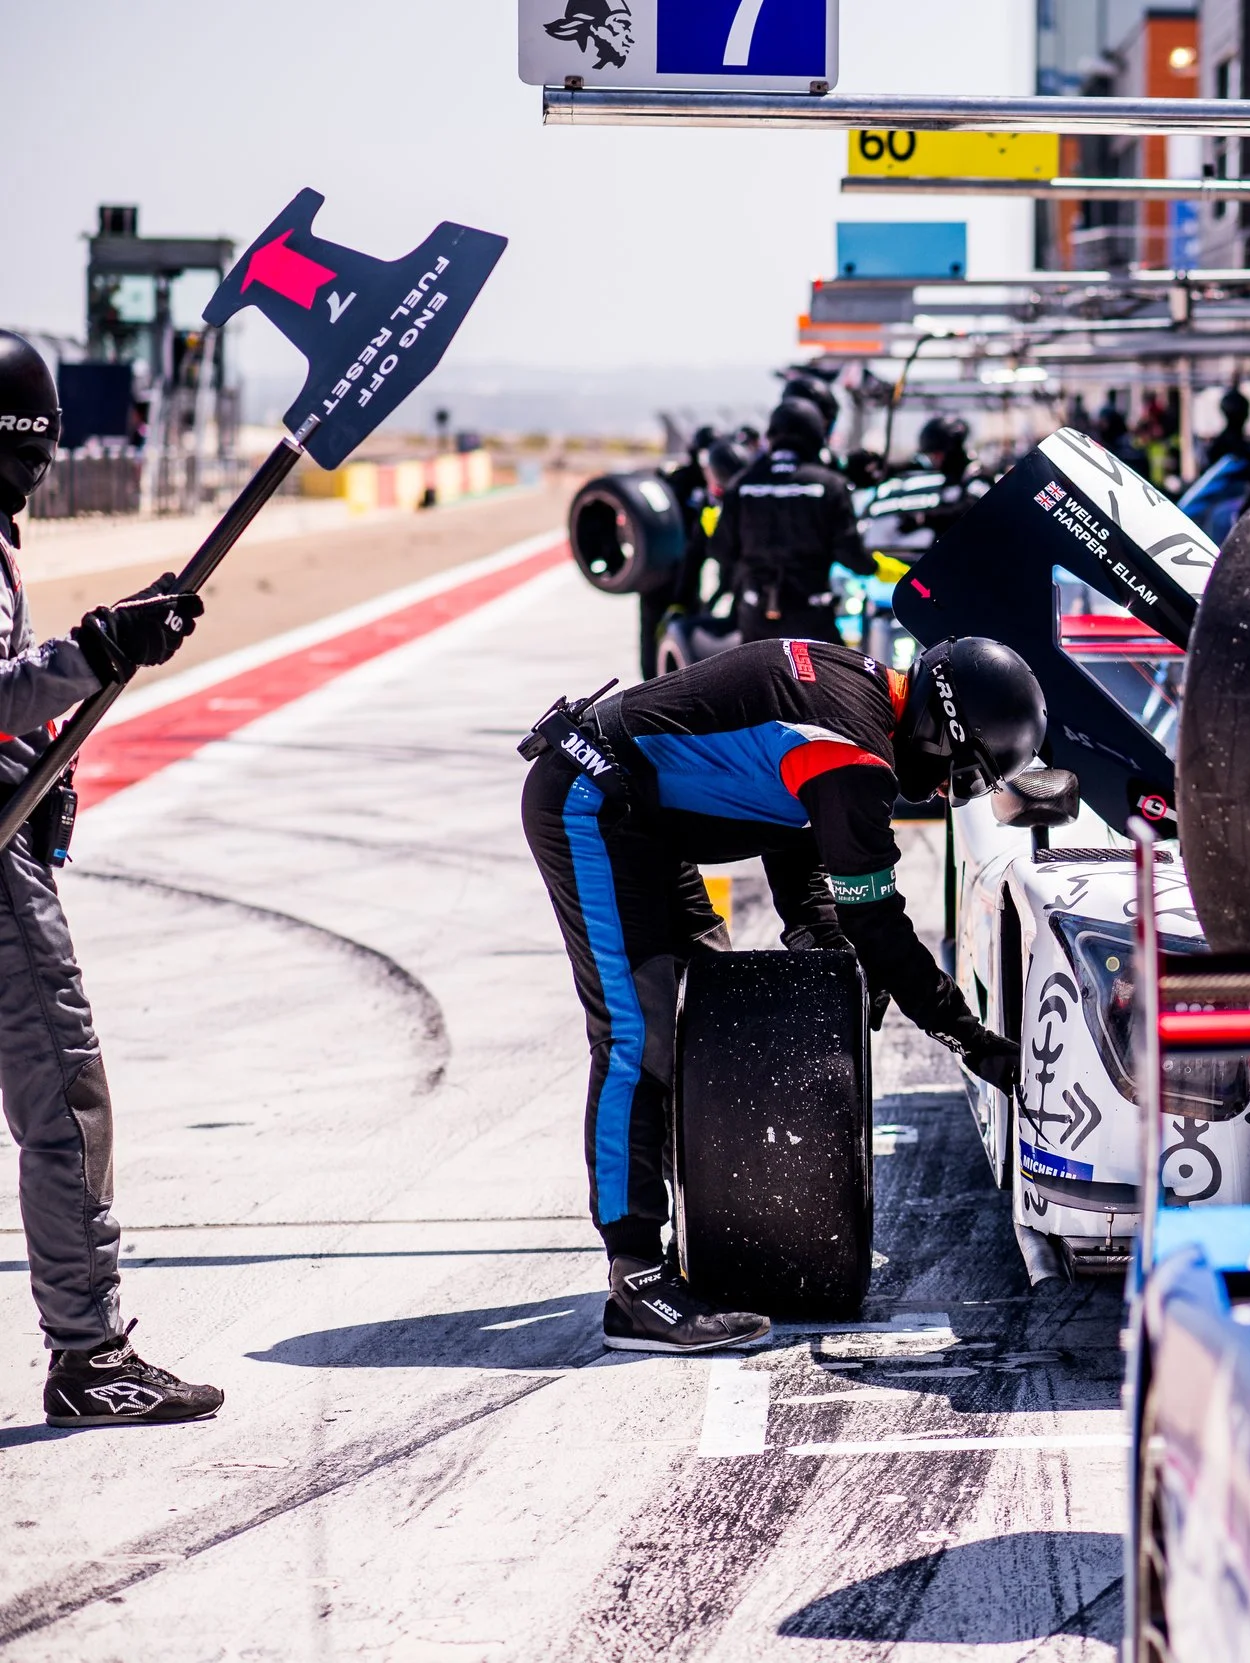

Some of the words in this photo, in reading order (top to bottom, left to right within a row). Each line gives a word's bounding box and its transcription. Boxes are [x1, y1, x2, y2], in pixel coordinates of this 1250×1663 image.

[859, 129, 916, 161] 60
[326, 290, 357, 324] 7
[390, 255, 450, 321] FUEL
[398, 291, 448, 348] ENG
[322, 327, 393, 415] RESET
[357, 354, 398, 408] OFF
[1064, 497, 1110, 540] WELLS
[1052, 508, 1107, 559] HARPER
[1112, 562, 1158, 606] ELLAM
[560, 732, 612, 776] MRTC
[653, 1298, 683, 1321] HRX
